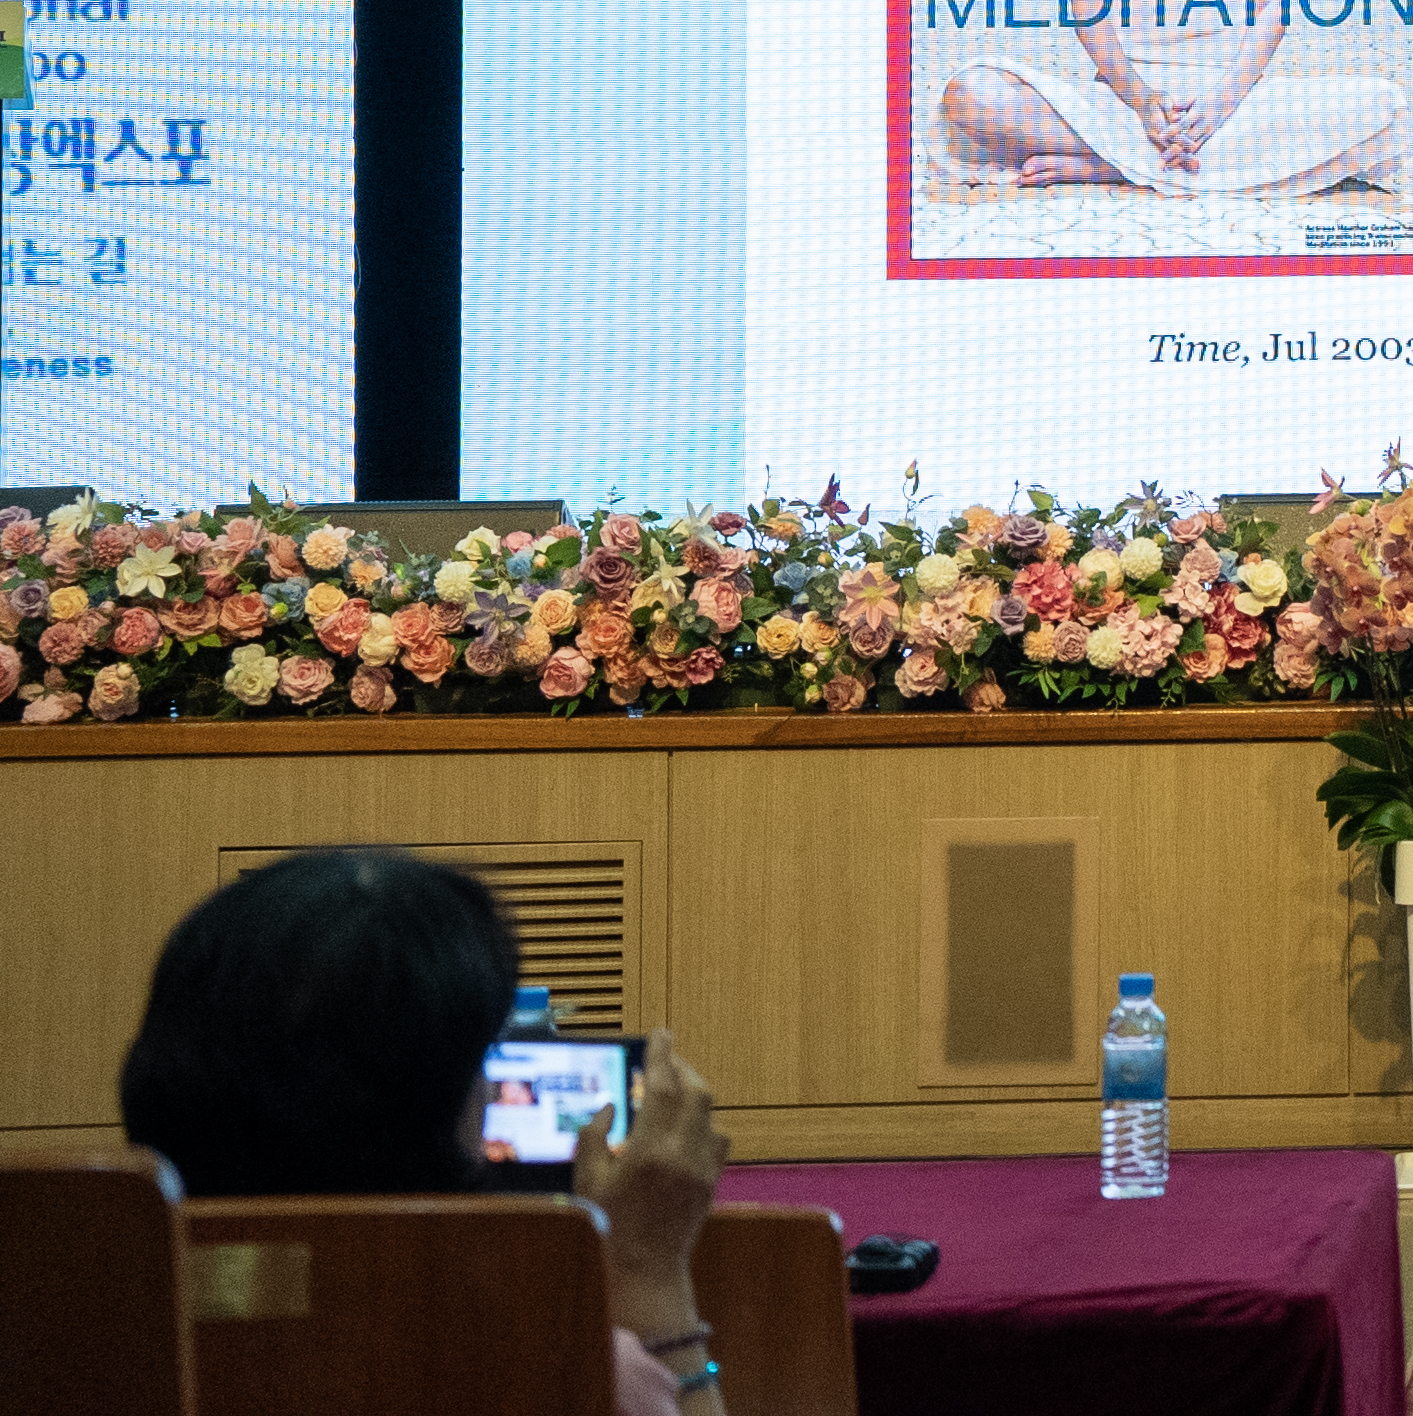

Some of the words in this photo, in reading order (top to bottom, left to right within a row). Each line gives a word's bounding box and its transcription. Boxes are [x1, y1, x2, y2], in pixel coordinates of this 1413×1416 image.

[82, 236, 127, 285] 길
[1147, 332, 1251, 367] Time,
[1261, 330, 1319, 363] Jul
